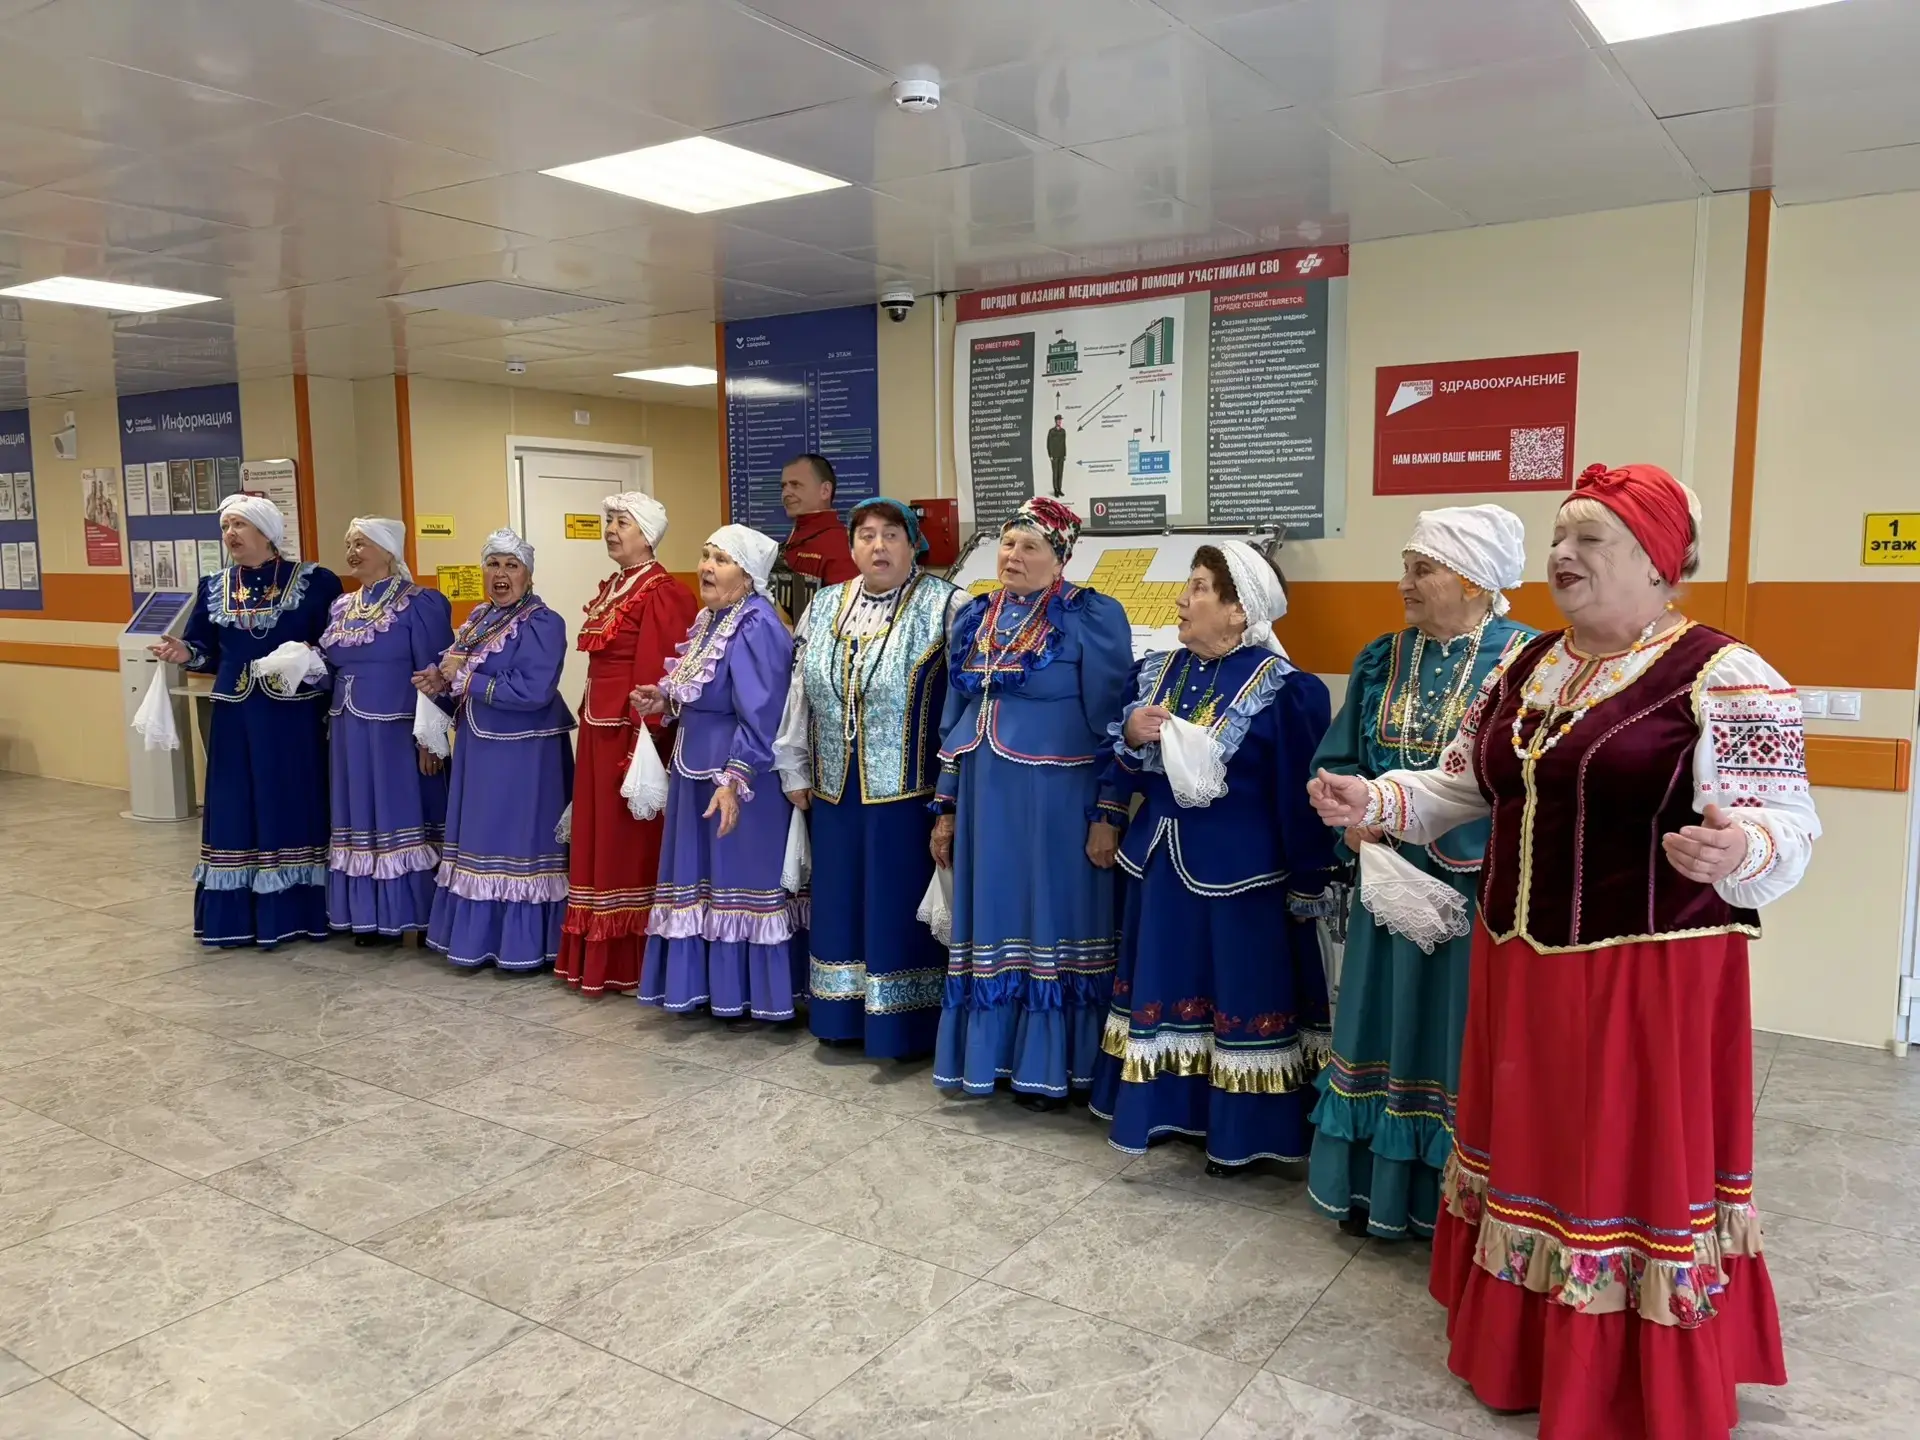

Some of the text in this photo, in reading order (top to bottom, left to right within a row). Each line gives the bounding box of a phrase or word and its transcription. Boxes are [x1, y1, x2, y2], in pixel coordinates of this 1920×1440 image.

[981, 259, 1280, 310] ПОРЯДОК ОКАЗАНИЯ МЕДИЦИНСКОЙ ПОМОЩИ УЧАСТНИКАМ СВО
[1214, 297, 1303, 312] ПОРЯДКЕ ОСУЩЕСТВЛЯЕТСЯ:
[1220, 292, 1268, 303] ПРИОРИТЕТНОМ
[1439, 373, 1566, 394] ЗДРАВООХРАНЕНИЕ
[161, 411, 233, 433] Информация
[1392, 450, 1502, 465] НАМ ВАЖНО ВАШЕ МНЕНИЕ
[1889, 519, 1899, 537] 1
[1871, 540, 1917, 551] этаж
